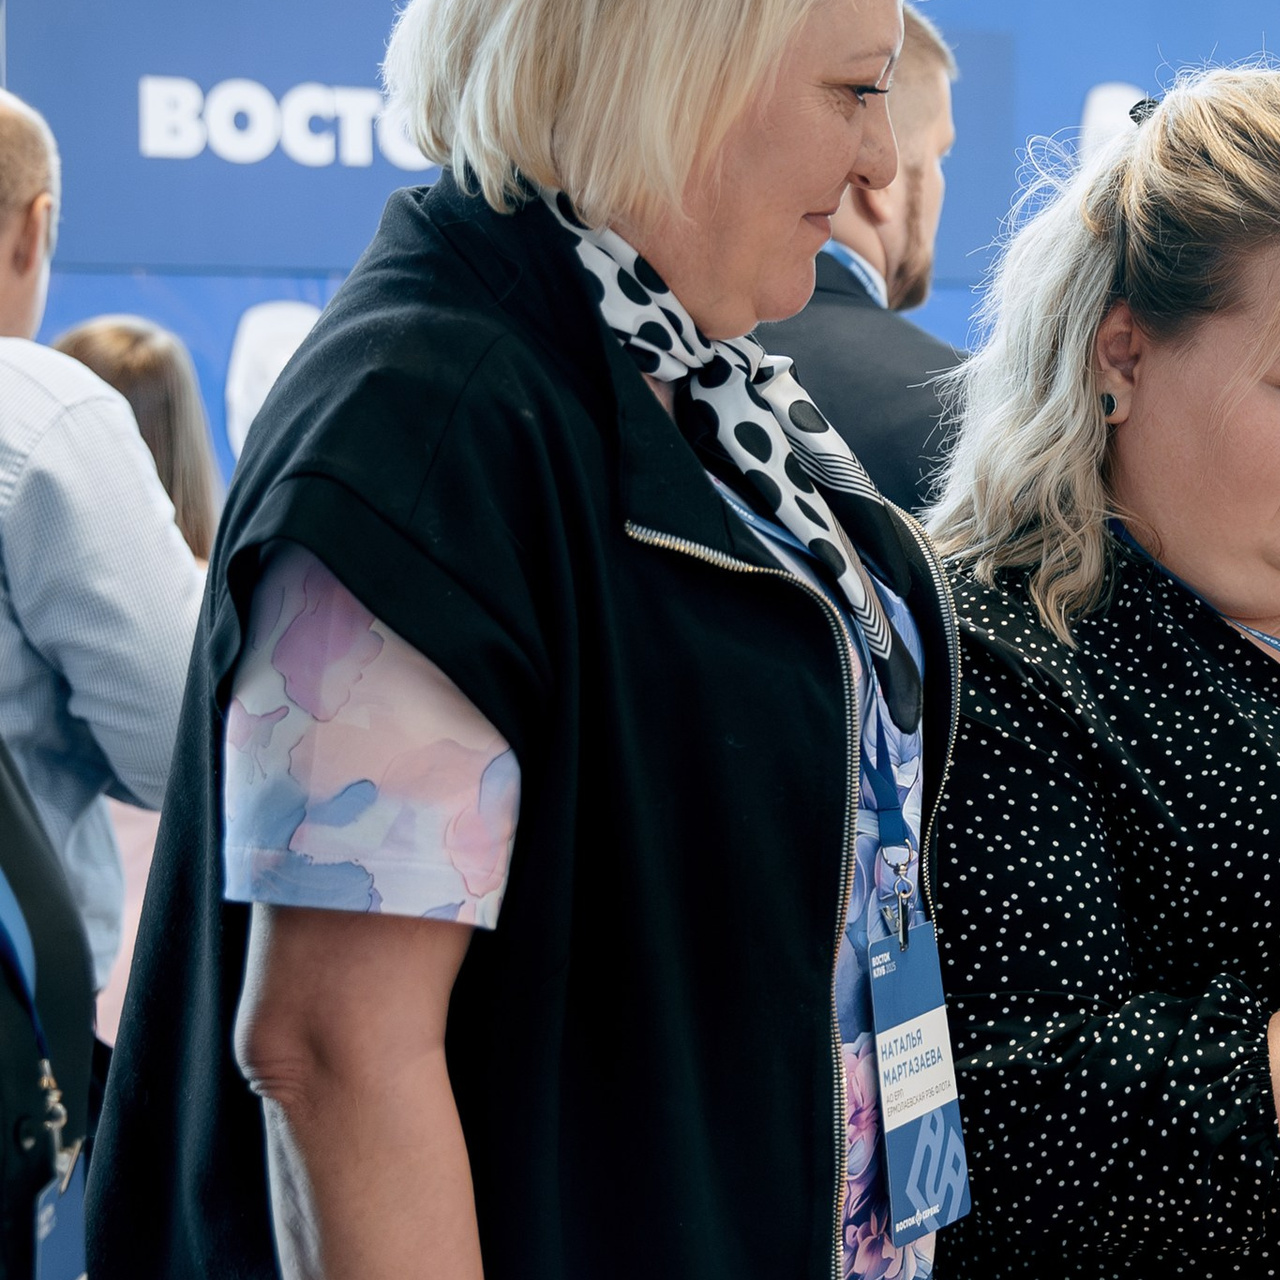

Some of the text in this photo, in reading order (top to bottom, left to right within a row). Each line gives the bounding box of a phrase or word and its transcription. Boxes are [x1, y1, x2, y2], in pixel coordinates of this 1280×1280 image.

[138, 75, 438, 171] ВОСТО
[880, 1028, 923, 1062] НАТАЛЬЯ
[882, 1046, 944, 1088] МАРТАЗАЕВА
